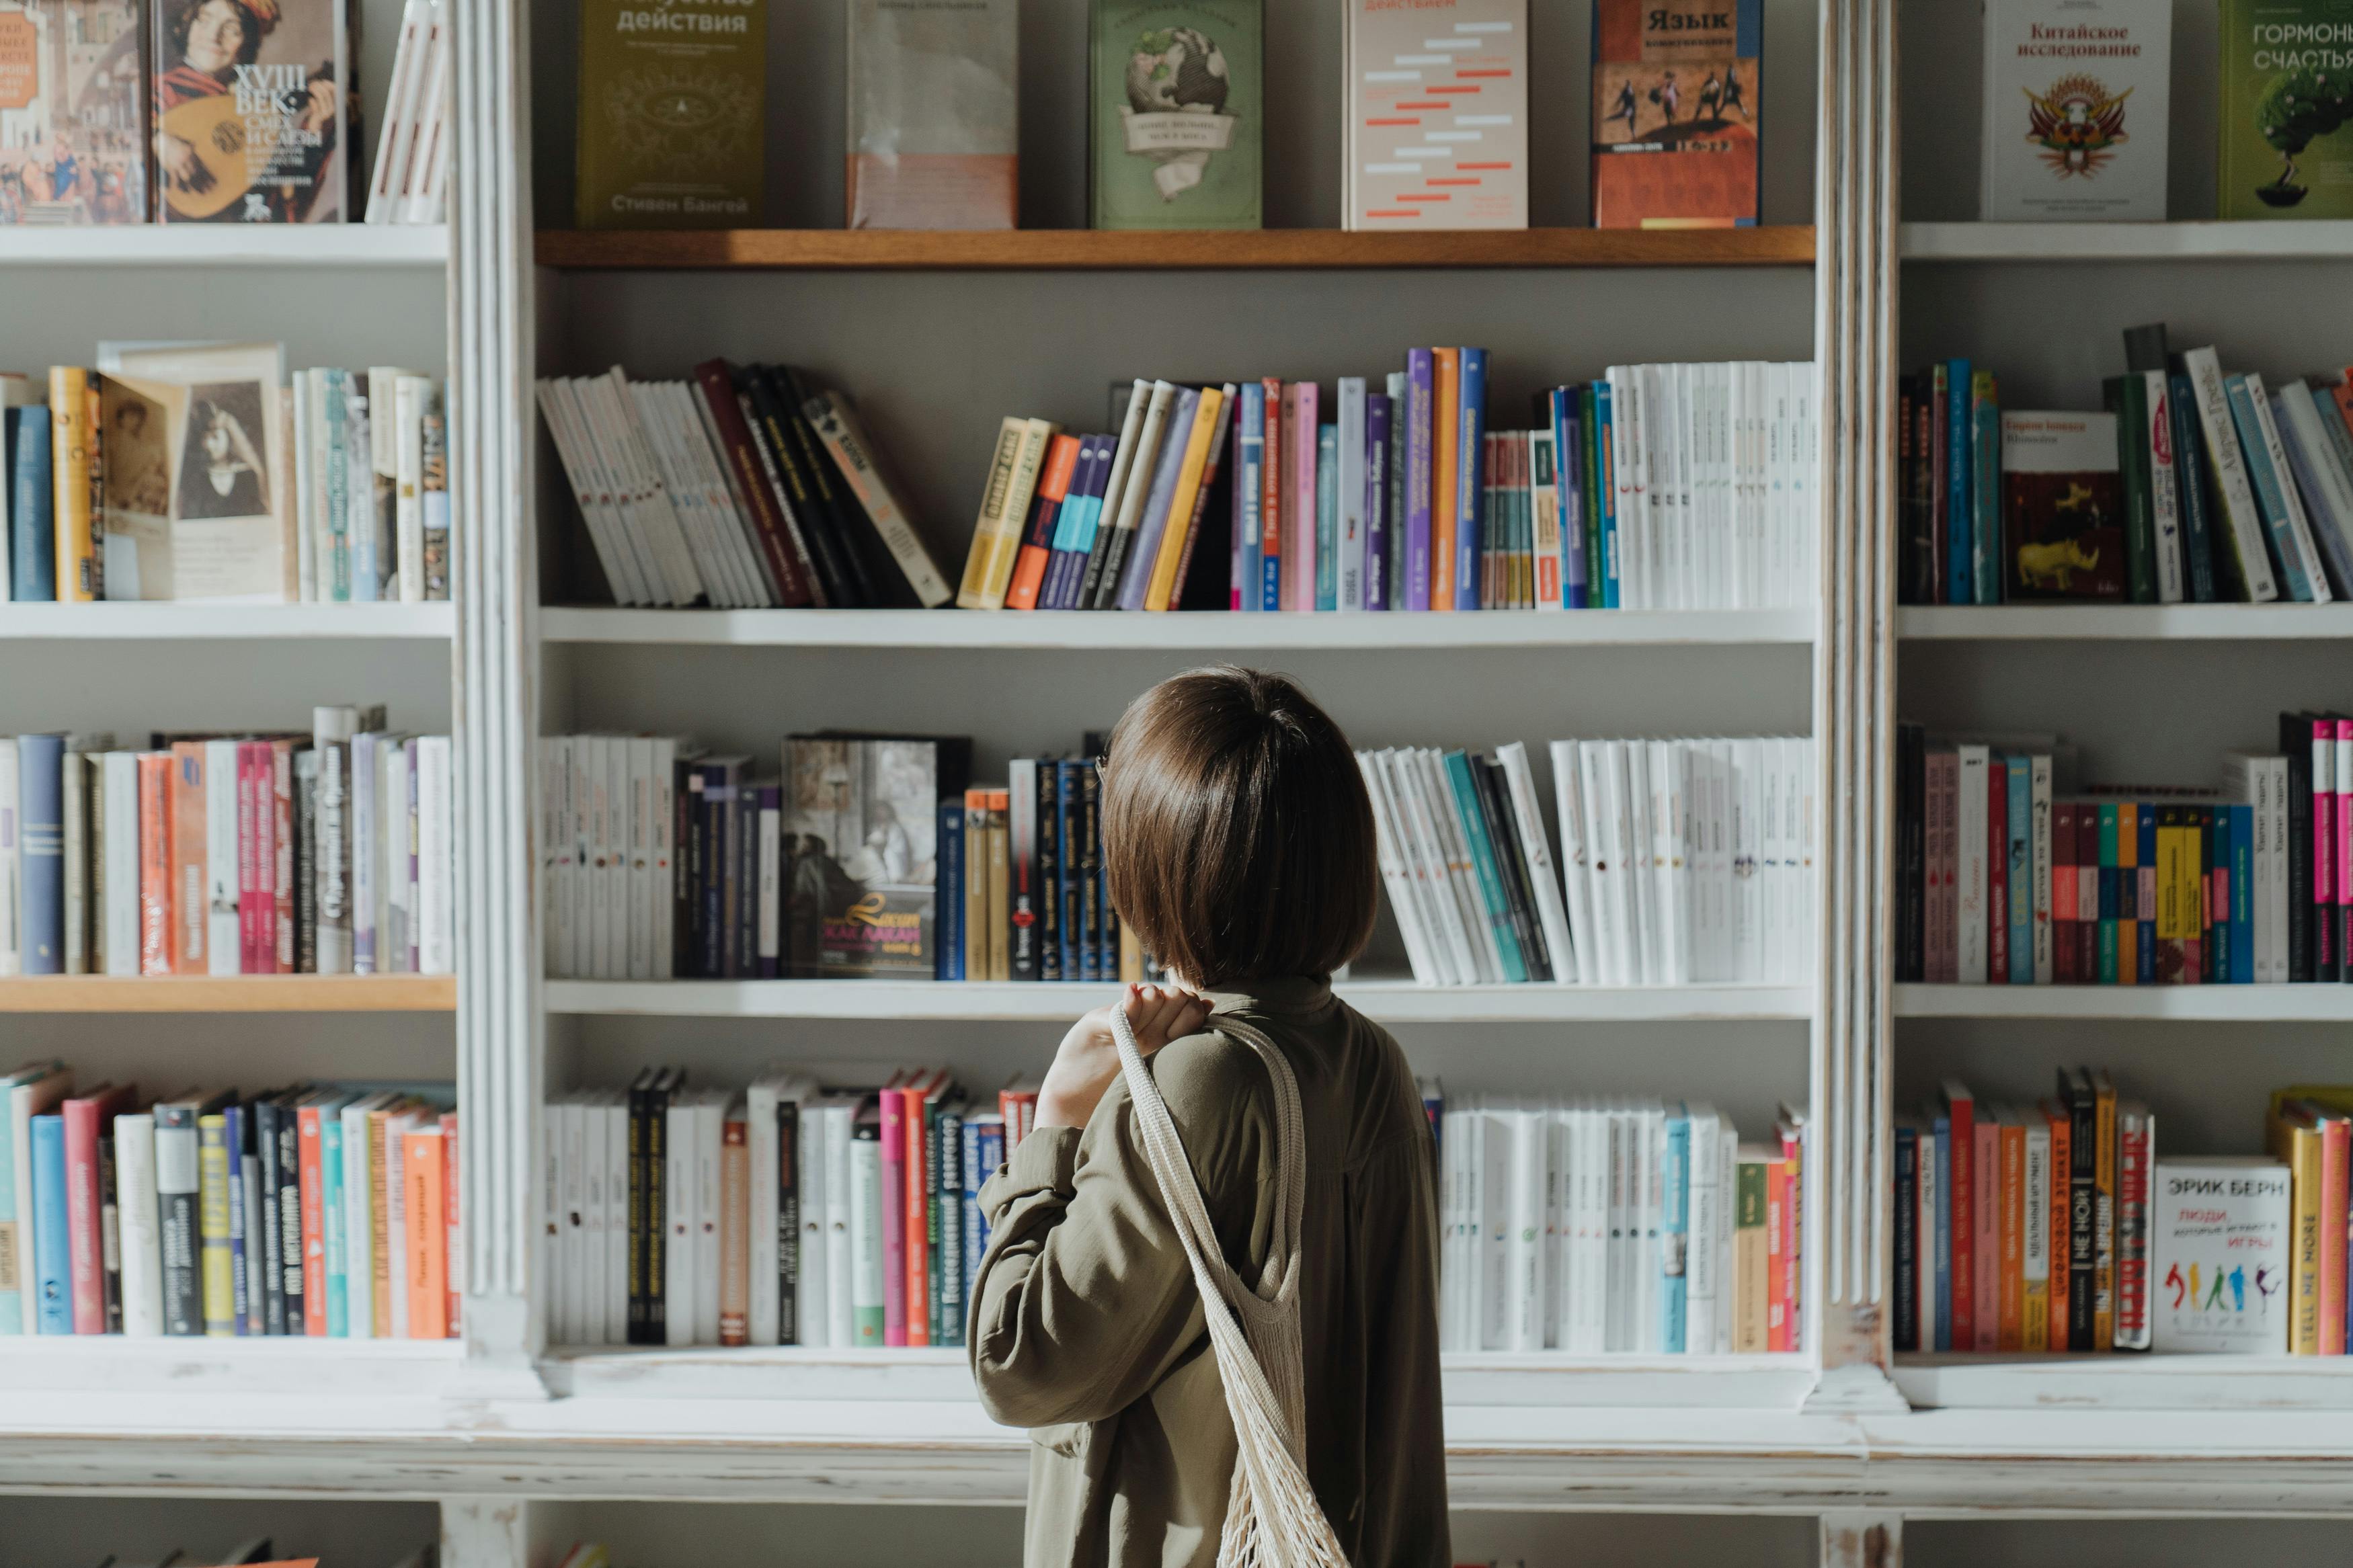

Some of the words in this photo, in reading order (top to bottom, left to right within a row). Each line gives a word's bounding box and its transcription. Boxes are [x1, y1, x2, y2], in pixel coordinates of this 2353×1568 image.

[616, 7, 747, 32] действия
[1648, 9, 1728, 30] Язык
[2030, 22, 2128, 40] Китайское
[2017, 44, 2141, 59] исследование
[233, 64, 307, 91] XVIII
[244, 115, 292, 130] СМЕХ
[246, 130, 260, 145] И
[611, 194, 678, 212] Стивен
[2054, 1138, 2067, 1200] ЭТИКЕТ
[2169, 1178, 2225, 1196] ЭРИК
[2230, 1178, 2284, 1197] БЕРН
[2072, 1189, 2090, 1231] НОЙ
[2073, 1233, 2090, 1259] НЕ
[2227, 1237, 2273, 1250] ИГРЫ
[2301, 1303, 2314, 1343] TELL
